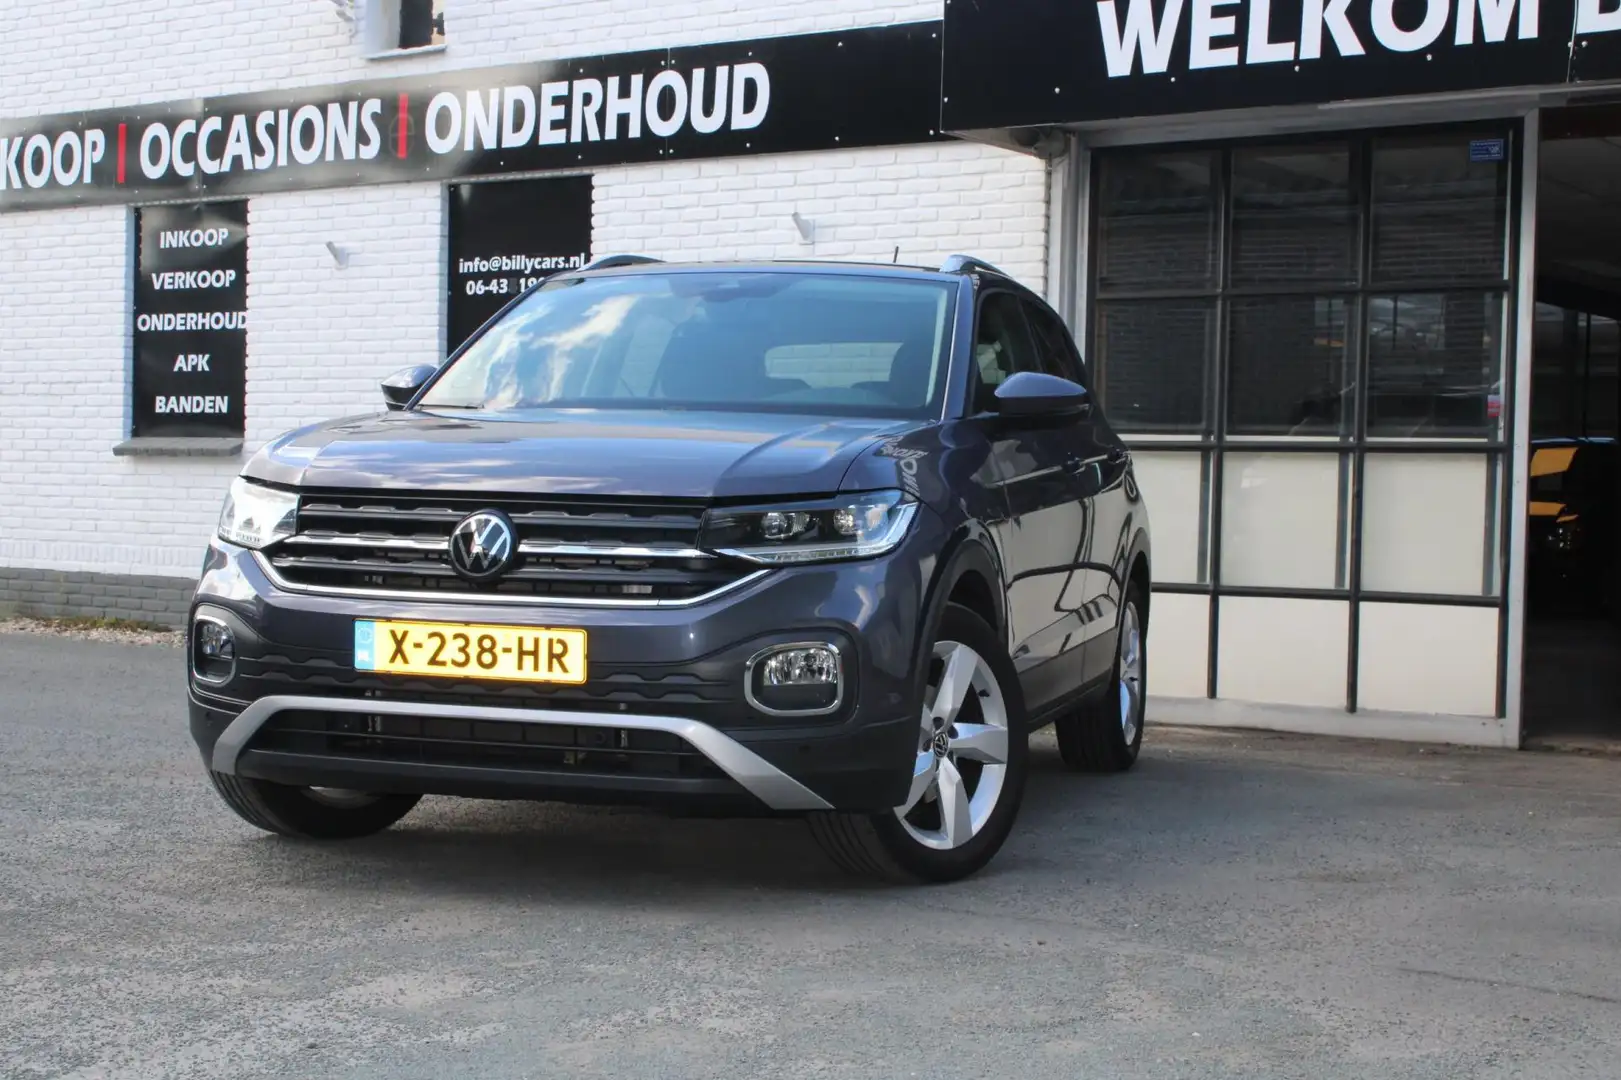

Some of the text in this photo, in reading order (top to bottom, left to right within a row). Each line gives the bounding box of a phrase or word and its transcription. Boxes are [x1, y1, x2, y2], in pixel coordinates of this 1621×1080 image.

[0, 62, 771, 190] KOOP OCCASIONS ONDERHOUD
[160, 227, 229, 249] INKOOP
[459, 253, 585, 274] info@billycars.nl
[151, 269, 236, 290] VERKOOP
[136, 312, 247, 331] ONDERHOUD
[173, 354, 210, 372] APK
[155, 396, 229, 413] BANDEN
[389, 629, 569, 673] X-238-HR
